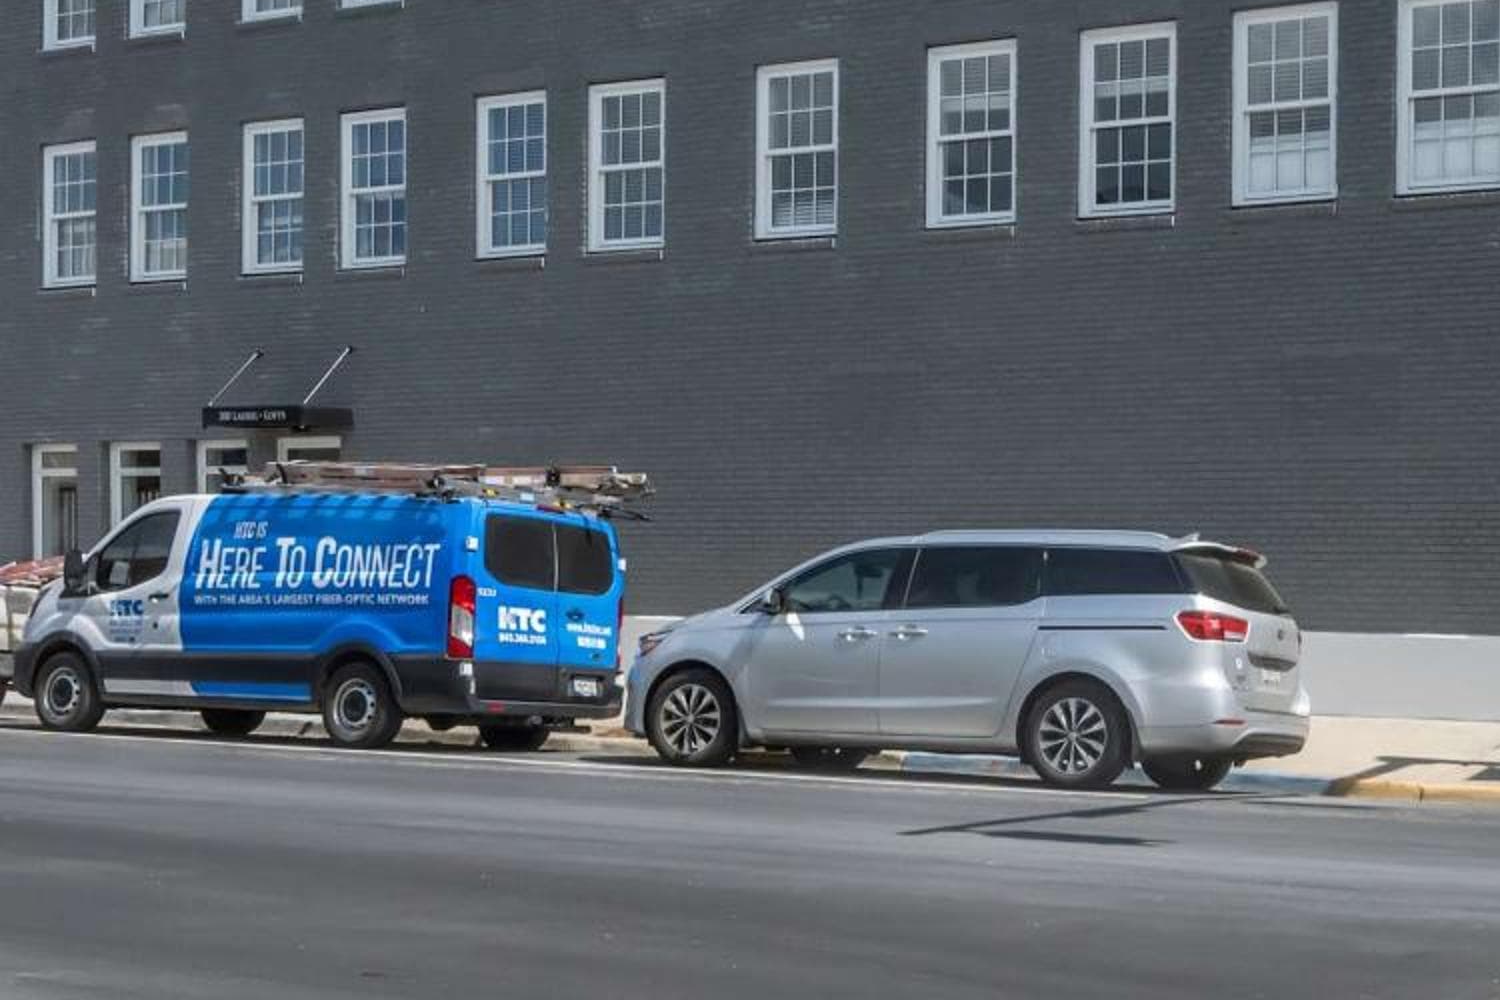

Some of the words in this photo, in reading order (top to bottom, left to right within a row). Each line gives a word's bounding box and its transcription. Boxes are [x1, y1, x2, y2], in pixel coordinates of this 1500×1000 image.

[195, 538, 266, 589] HERE
[275, 537, 307, 589] TO
[311, 536, 441, 589] CONNECT
[194, 594, 218, 605] WITH
[219, 594, 236, 605] THE
[272, 594, 314, 605] LARGEST
[377, 594, 430, 605] NETWORK
